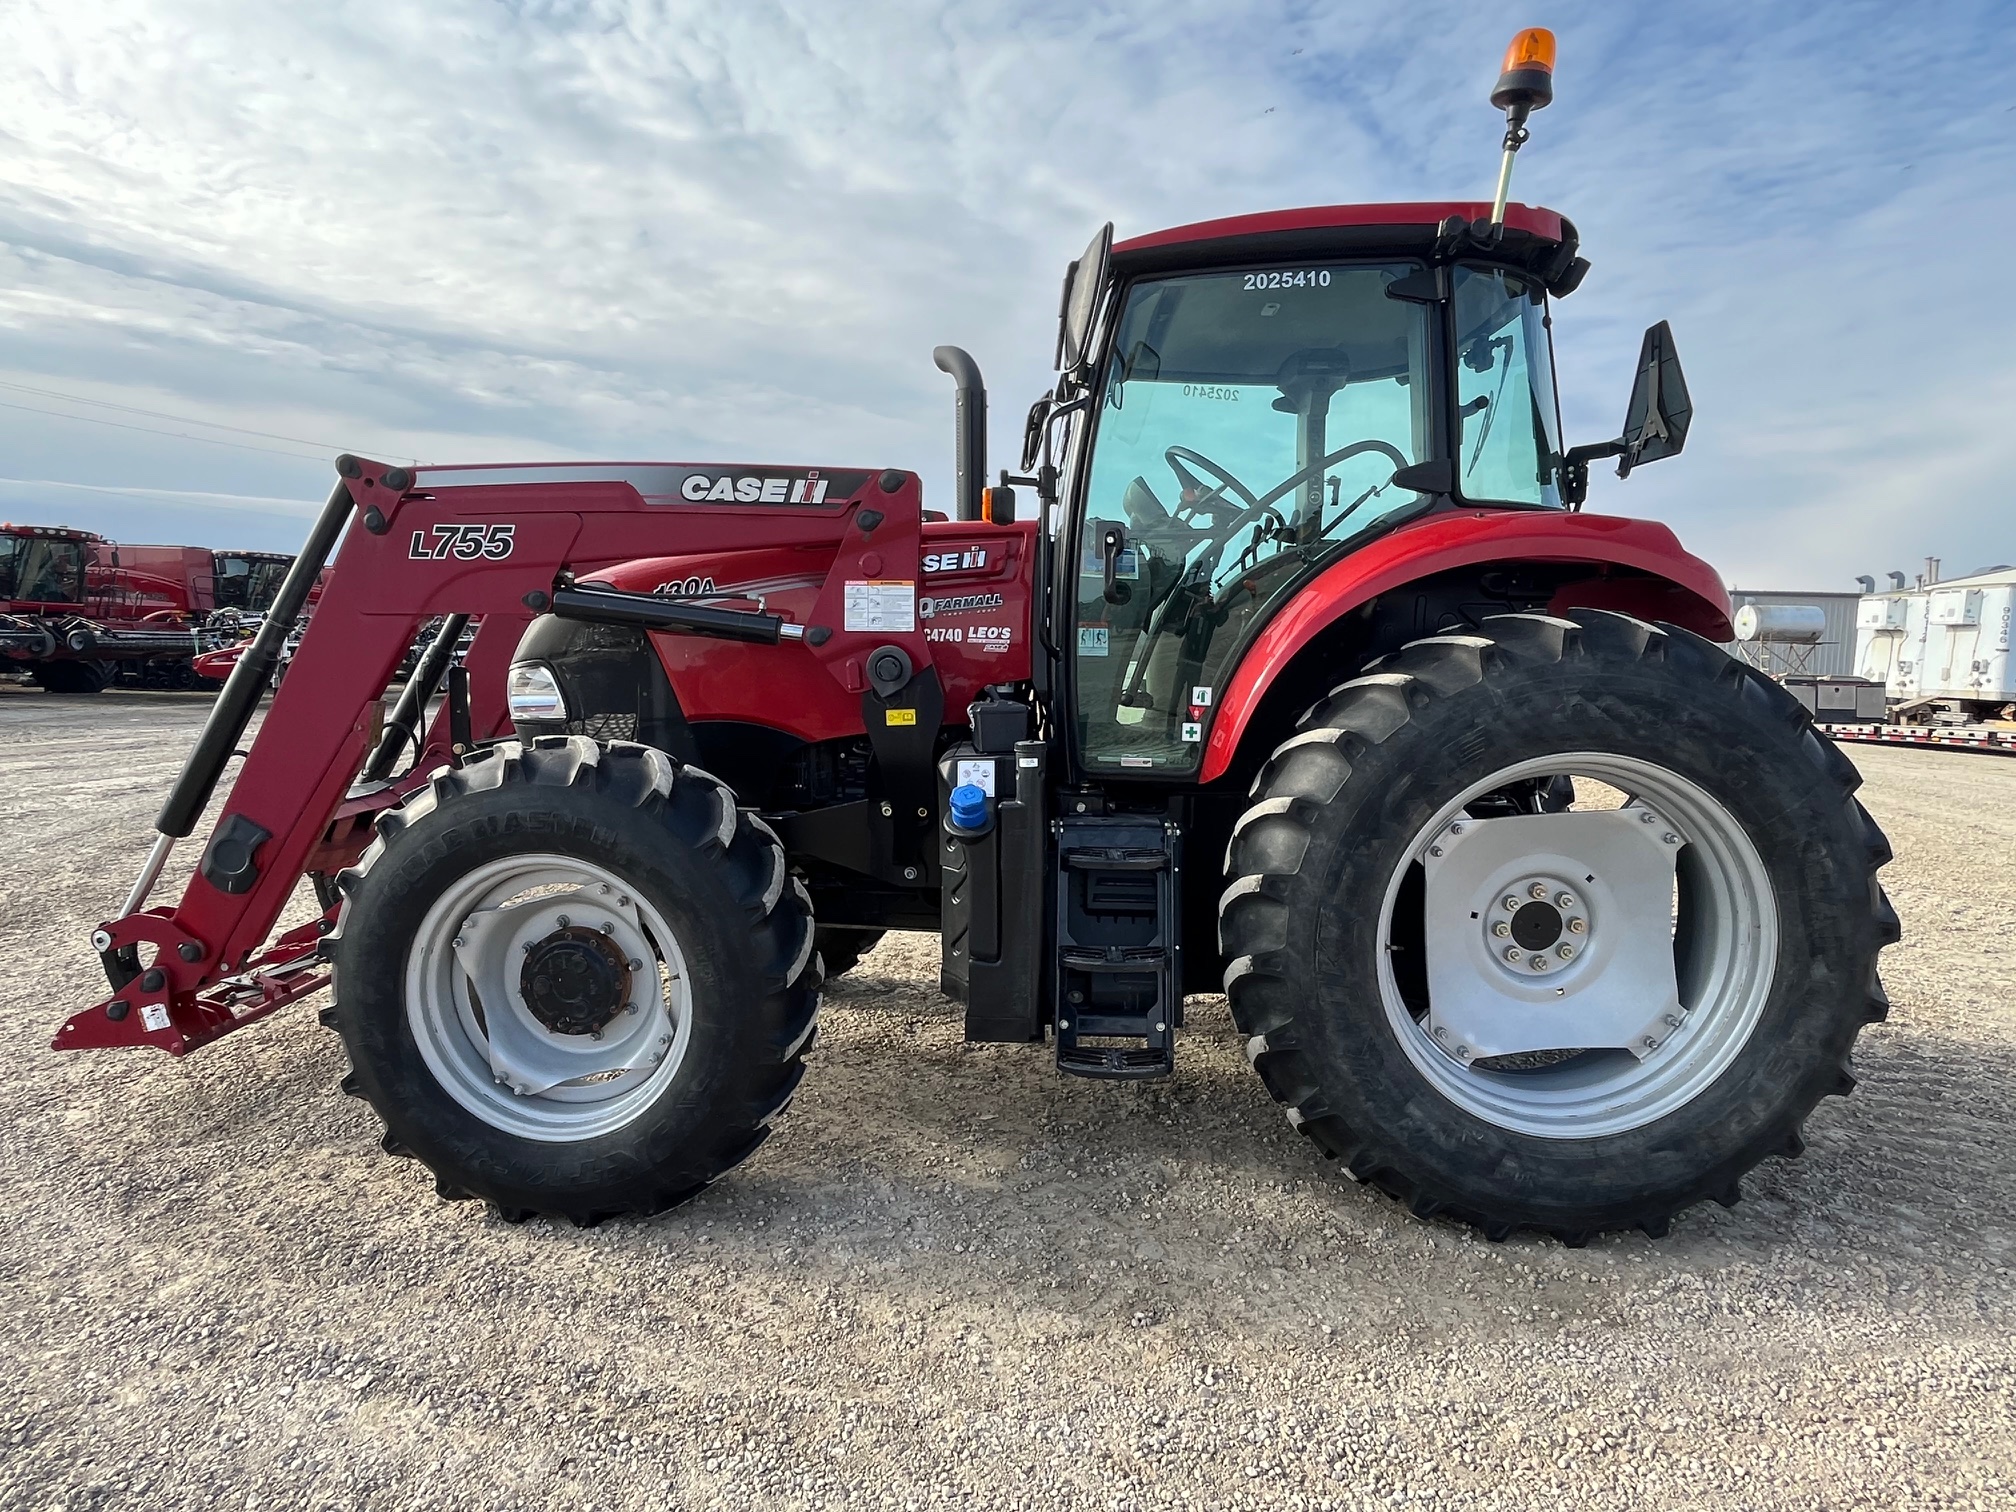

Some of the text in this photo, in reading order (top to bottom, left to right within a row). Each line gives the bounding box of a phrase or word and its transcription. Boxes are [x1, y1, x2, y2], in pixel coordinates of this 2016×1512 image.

[1243, 270, 1331, 290] 2025410
[680, 474, 790, 502] CASE
[408, 523, 516, 560] L755
[922, 553, 959, 572] SE
[934, 593, 1003, 612] FARMALL
[967, 626, 1011, 640] LEO'S
